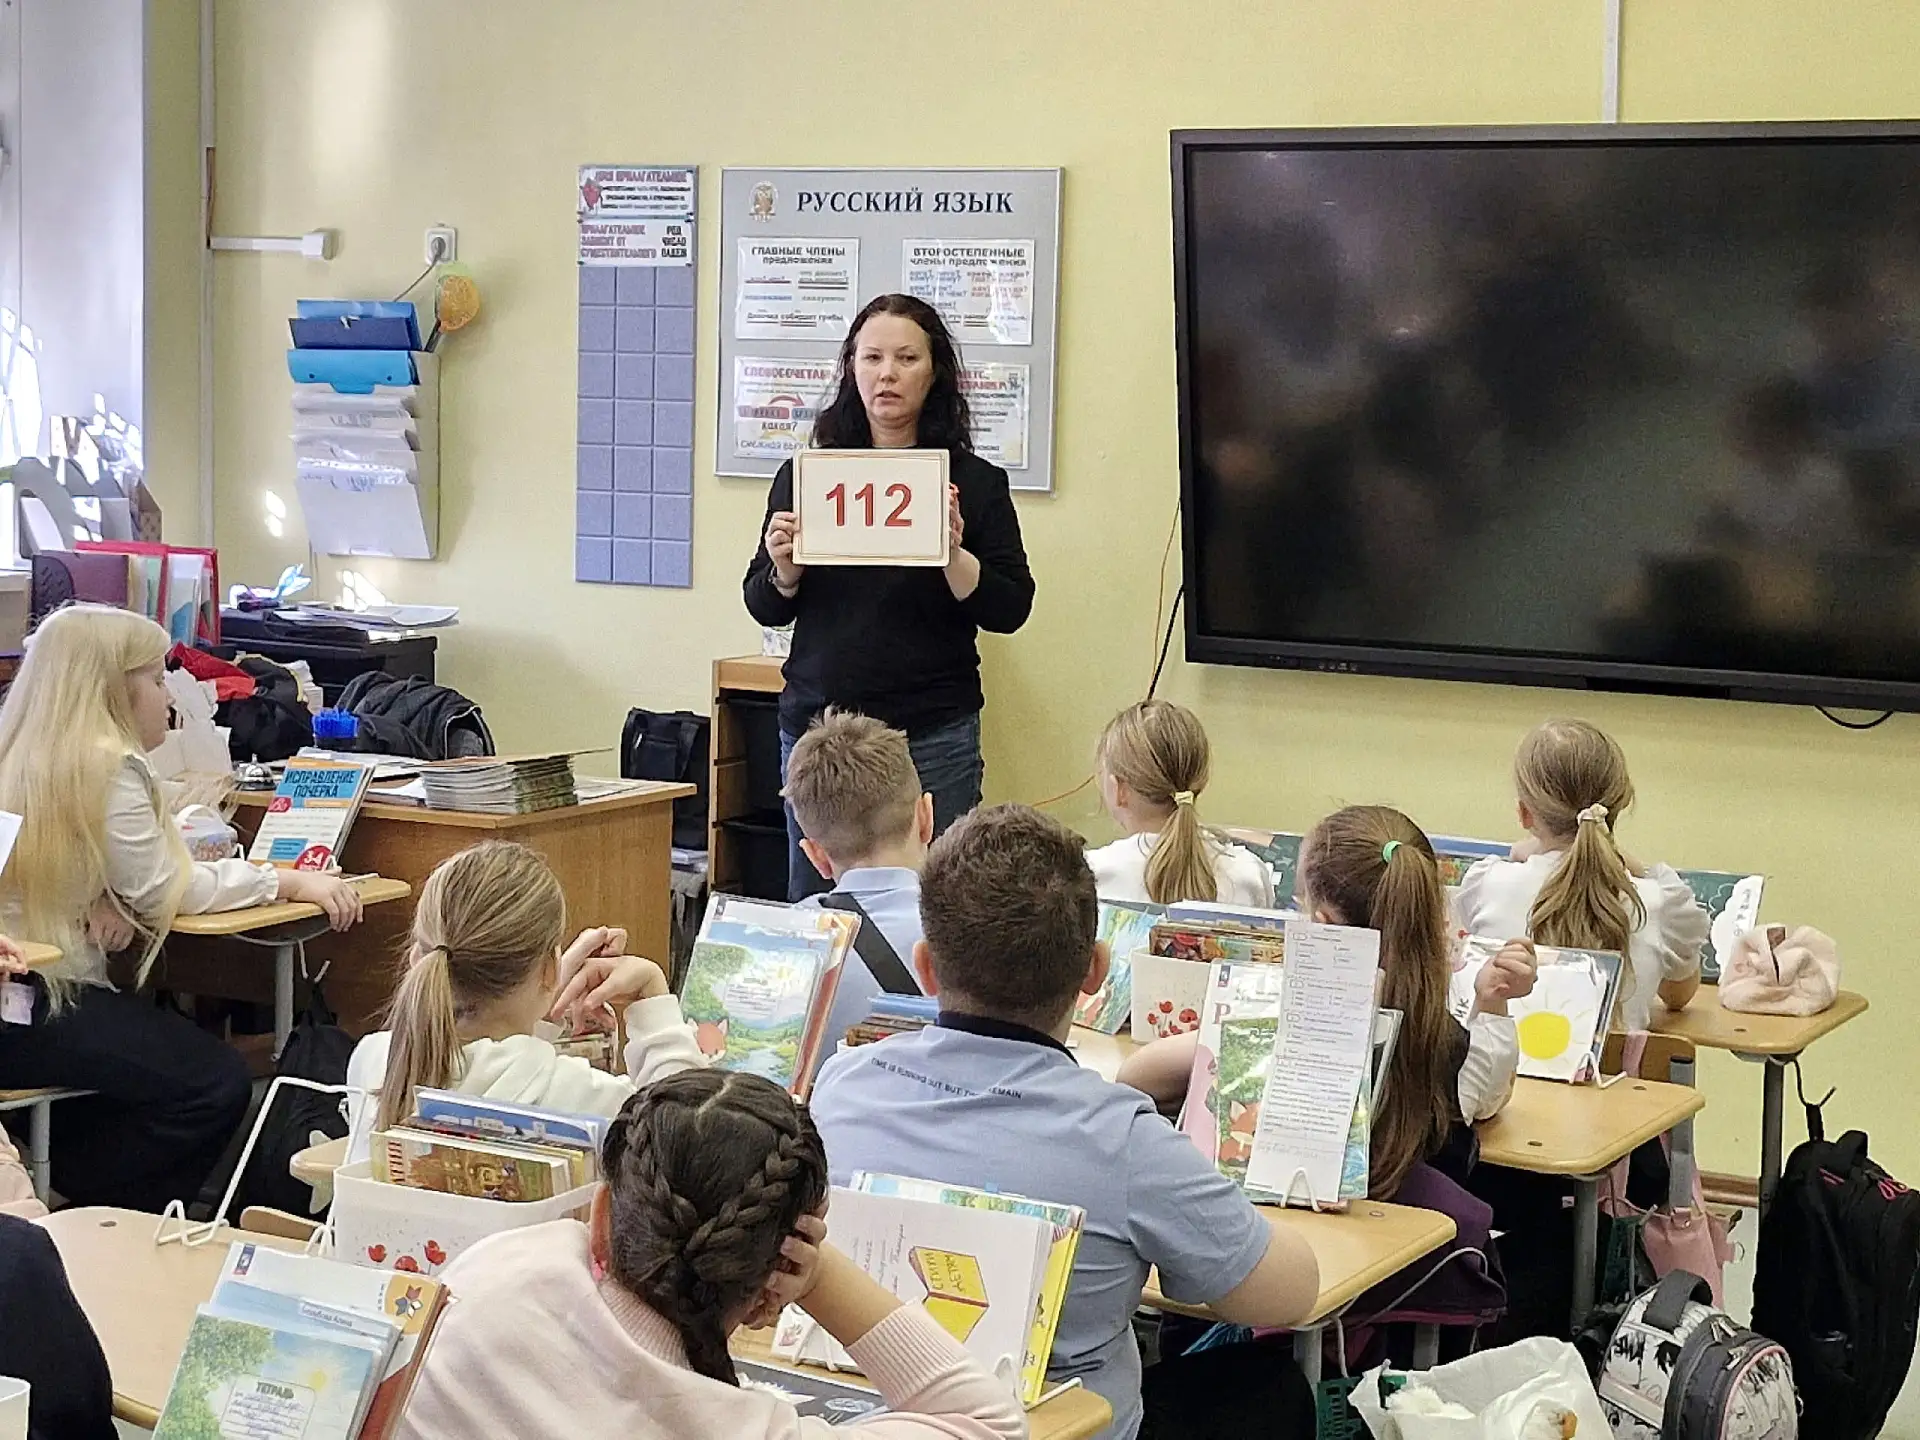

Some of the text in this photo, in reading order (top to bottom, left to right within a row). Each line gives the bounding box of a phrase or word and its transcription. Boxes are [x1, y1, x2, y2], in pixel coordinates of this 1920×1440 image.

[797, 187, 1014, 213] РУССКИЙ ЯЗЫК
[751, 247, 846, 256] ГЛАВНЫЕ ЧЛЕНЫ
[913, 248, 1025, 258] ВТОРОСТЕПЕННЫЕ
[825, 483, 912, 527] 112
[284, 770, 356, 784] ИСПРАВЛЕНИЕ
[293, 784, 339, 797] ПОЧЕРКА
[988, 1087, 1023, 1099] EMAIN
